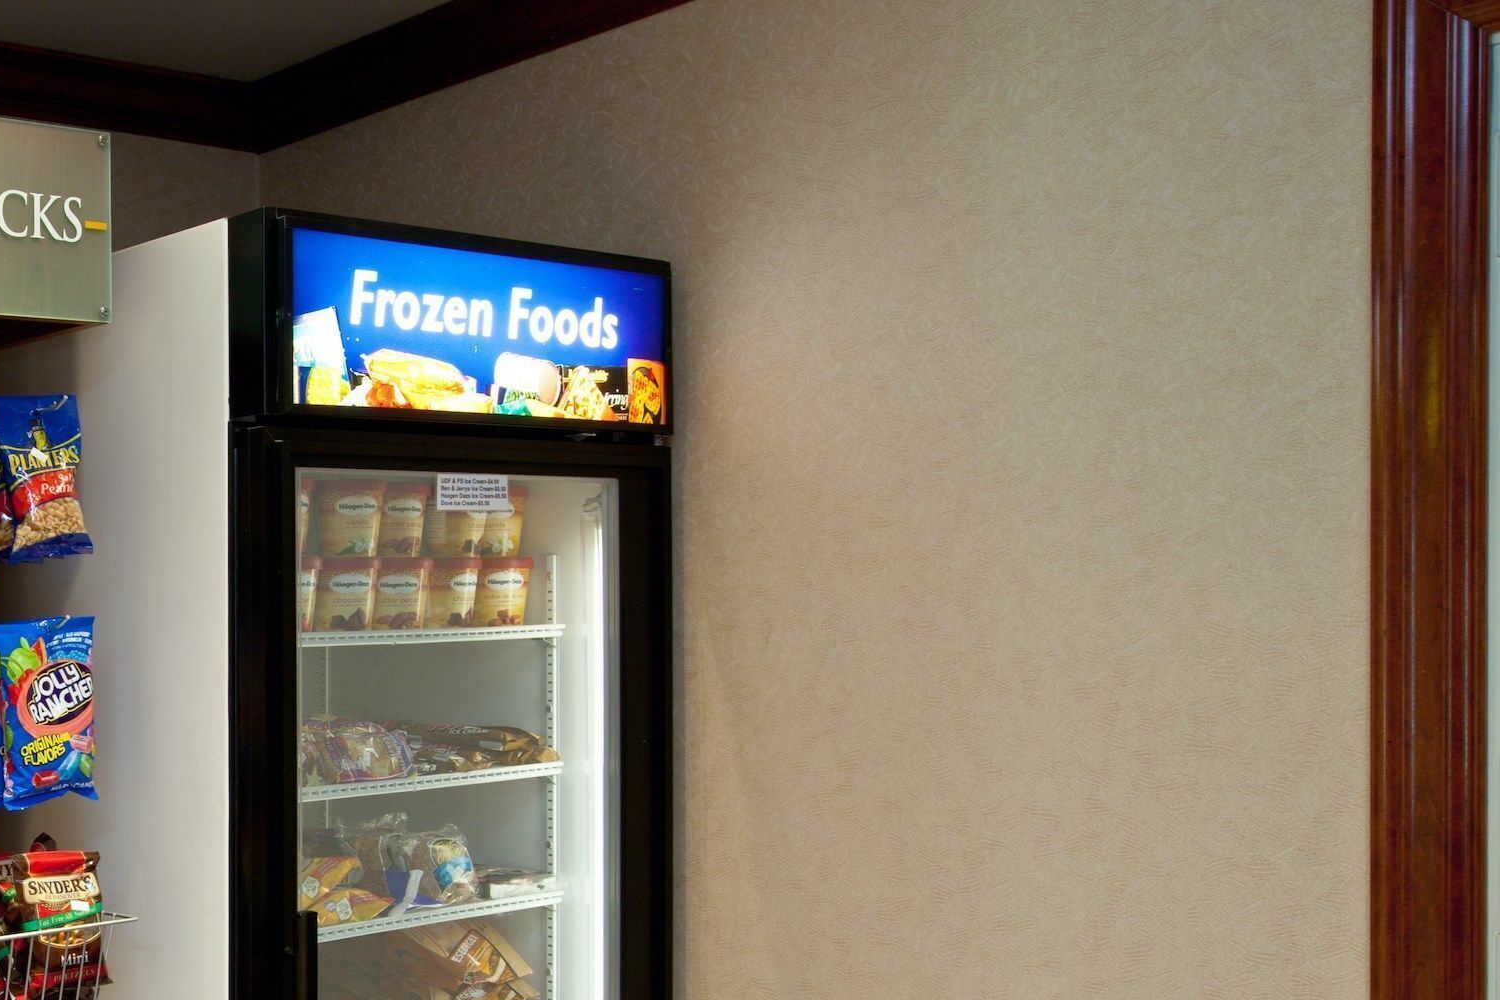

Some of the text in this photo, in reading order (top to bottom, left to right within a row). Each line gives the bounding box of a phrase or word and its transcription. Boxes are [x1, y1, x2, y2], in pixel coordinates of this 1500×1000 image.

[349, 268, 619, 349] Frozen Foods
[33, 664, 79, 700] JOLLY
[21, 734, 63, 757] ORIGINAL
[24, 744, 66, 766] FLAVORS
